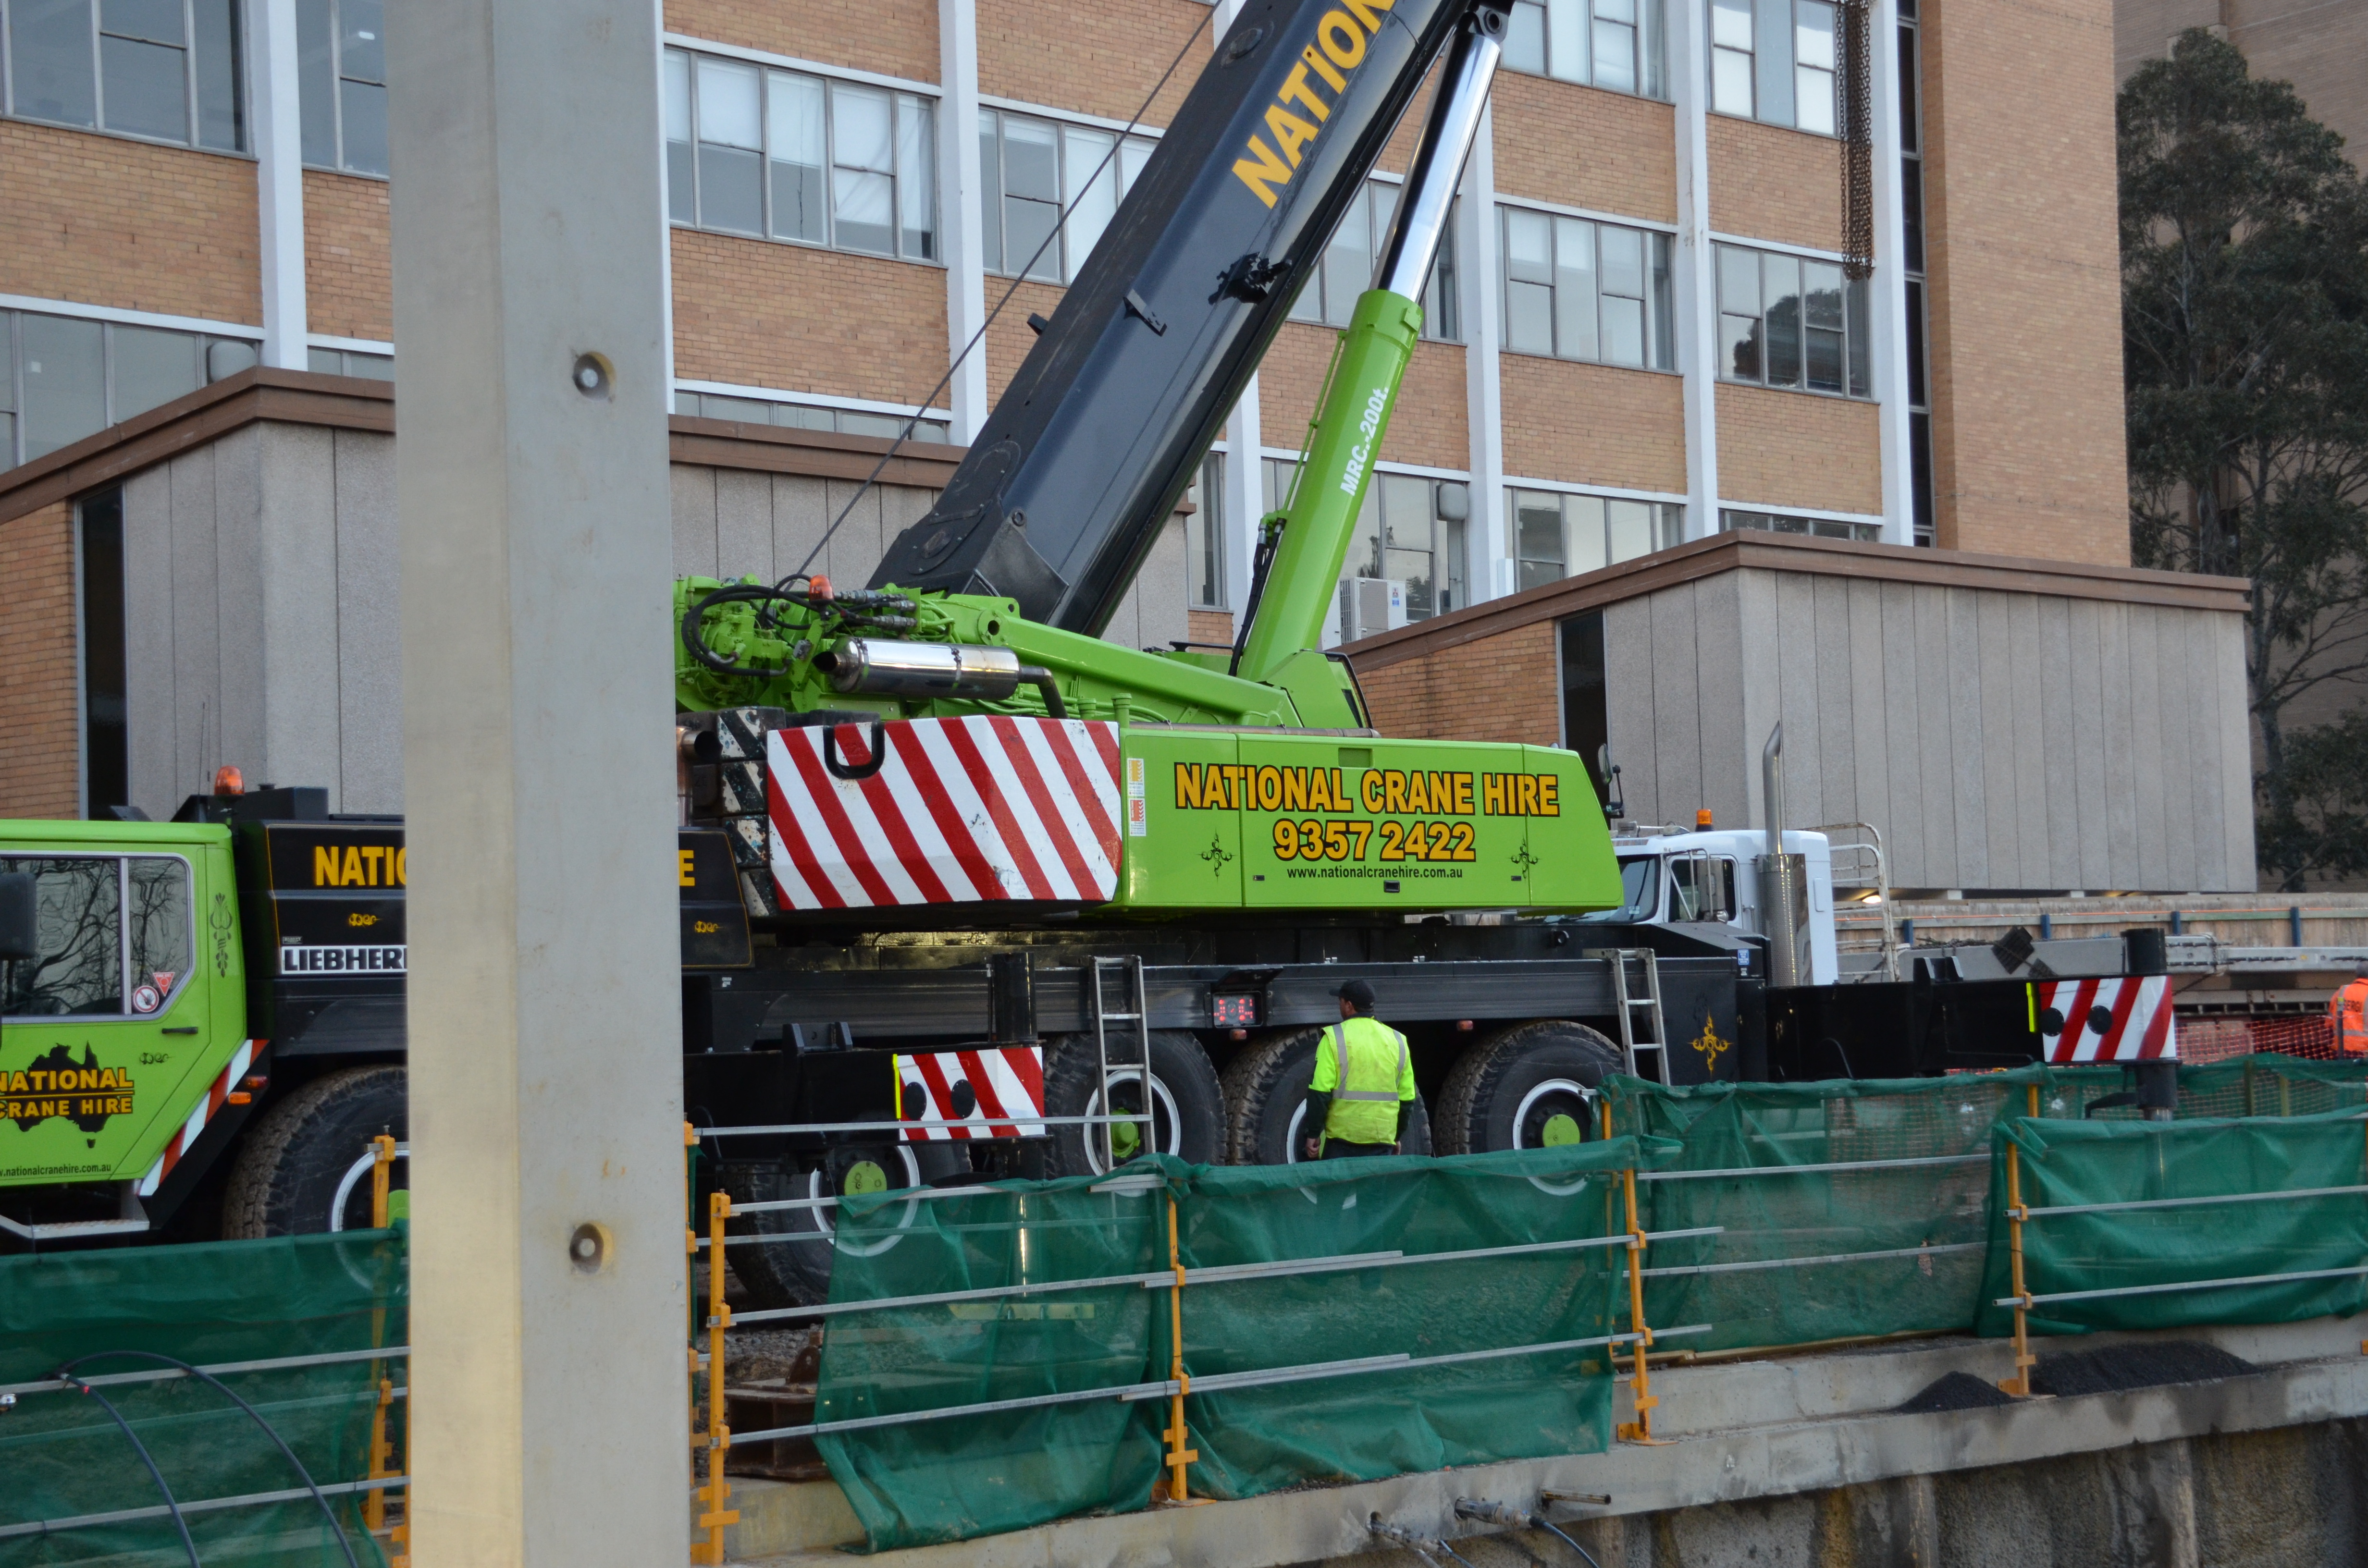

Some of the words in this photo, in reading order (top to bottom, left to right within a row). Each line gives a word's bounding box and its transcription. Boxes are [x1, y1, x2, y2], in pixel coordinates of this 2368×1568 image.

[1174, 762, 1354, 813] NATIONAL
[1360, 769, 1475, 815] CRANE
[1482, 772, 1560, 817] HIRE
[1273, 818, 1373, 861] 9357
[1379, 821, 1476, 862] 2422
[1287, 865, 1463, 878] www.nationalcranehire.com.au
[284, 948, 407, 971] LIEBHER
[81, 1096, 133, 1115] HIRE
